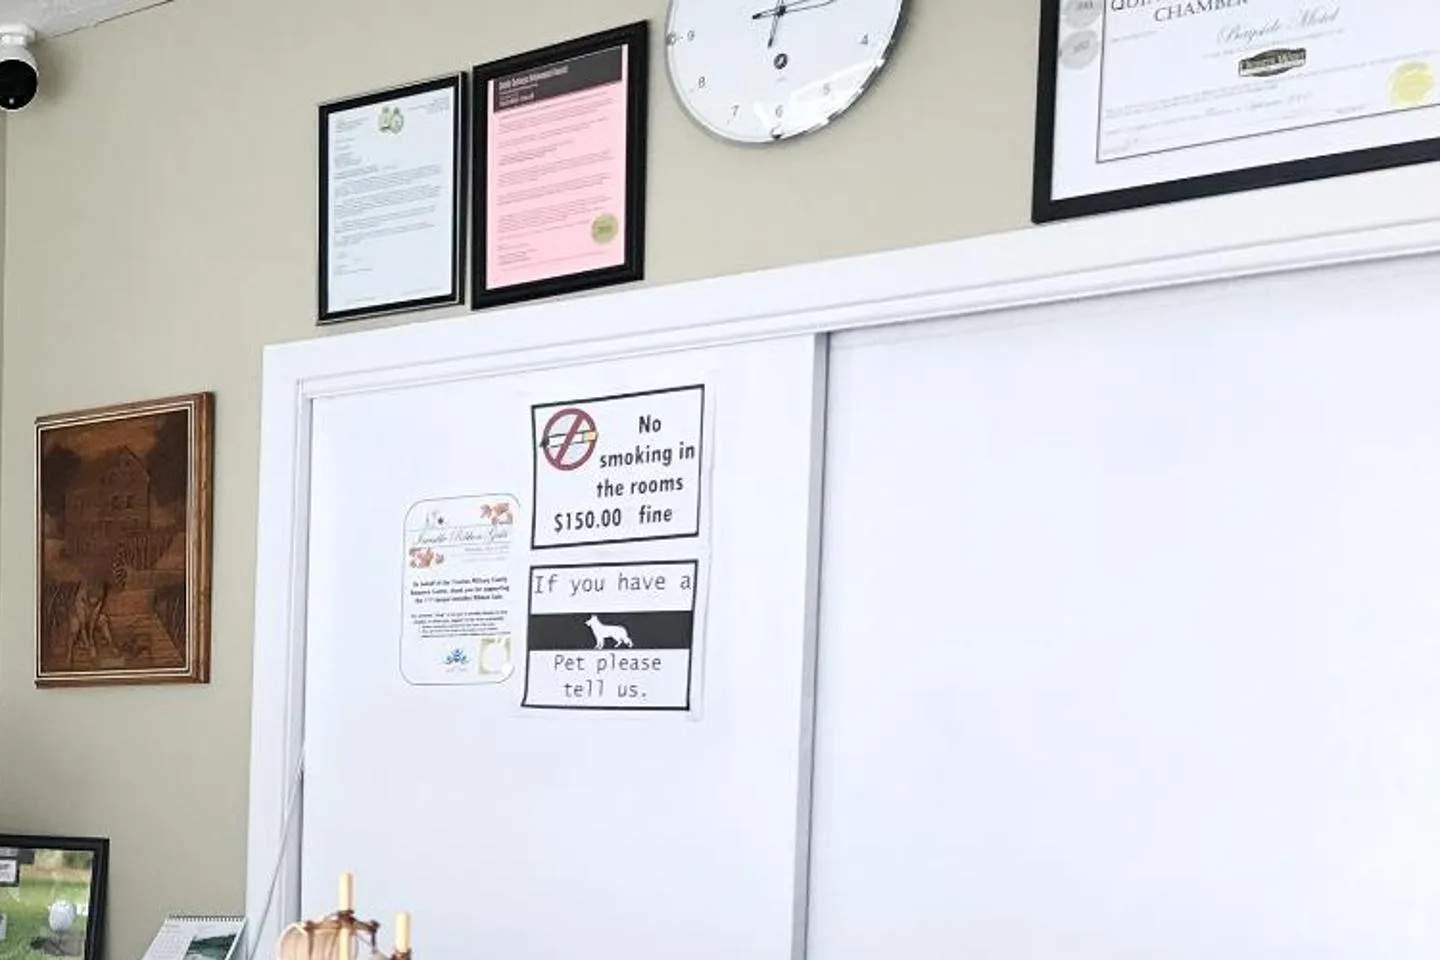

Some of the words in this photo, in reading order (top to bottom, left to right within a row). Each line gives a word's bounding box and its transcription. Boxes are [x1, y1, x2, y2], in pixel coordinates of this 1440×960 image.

[687, 31, 695, 41] 9
[860, 34, 869, 45] 4
[698, 77, 706, 88] 8
[731, 105, 739, 117] 7
[775, 105, 784, 118] 6
[638, 415, 662, 434] No
[599, 444, 673, 469] smoking
[678, 441, 695, 460] in
[596, 479, 625, 498] the
[630, 475, 684, 495] rooms
[554, 508, 622, 533] $150.00
[638, 505, 673, 525] fine
[533, 574, 558, 595] If
[570, 575, 605, 596] you
[617, 571, 666, 592] have
[680, 574, 692, 590] a
[554, 654, 585, 672] Pet
[596, 653, 662, 678] please
[563, 681, 604, 698] tell
[617, 682, 648, 699] us.
